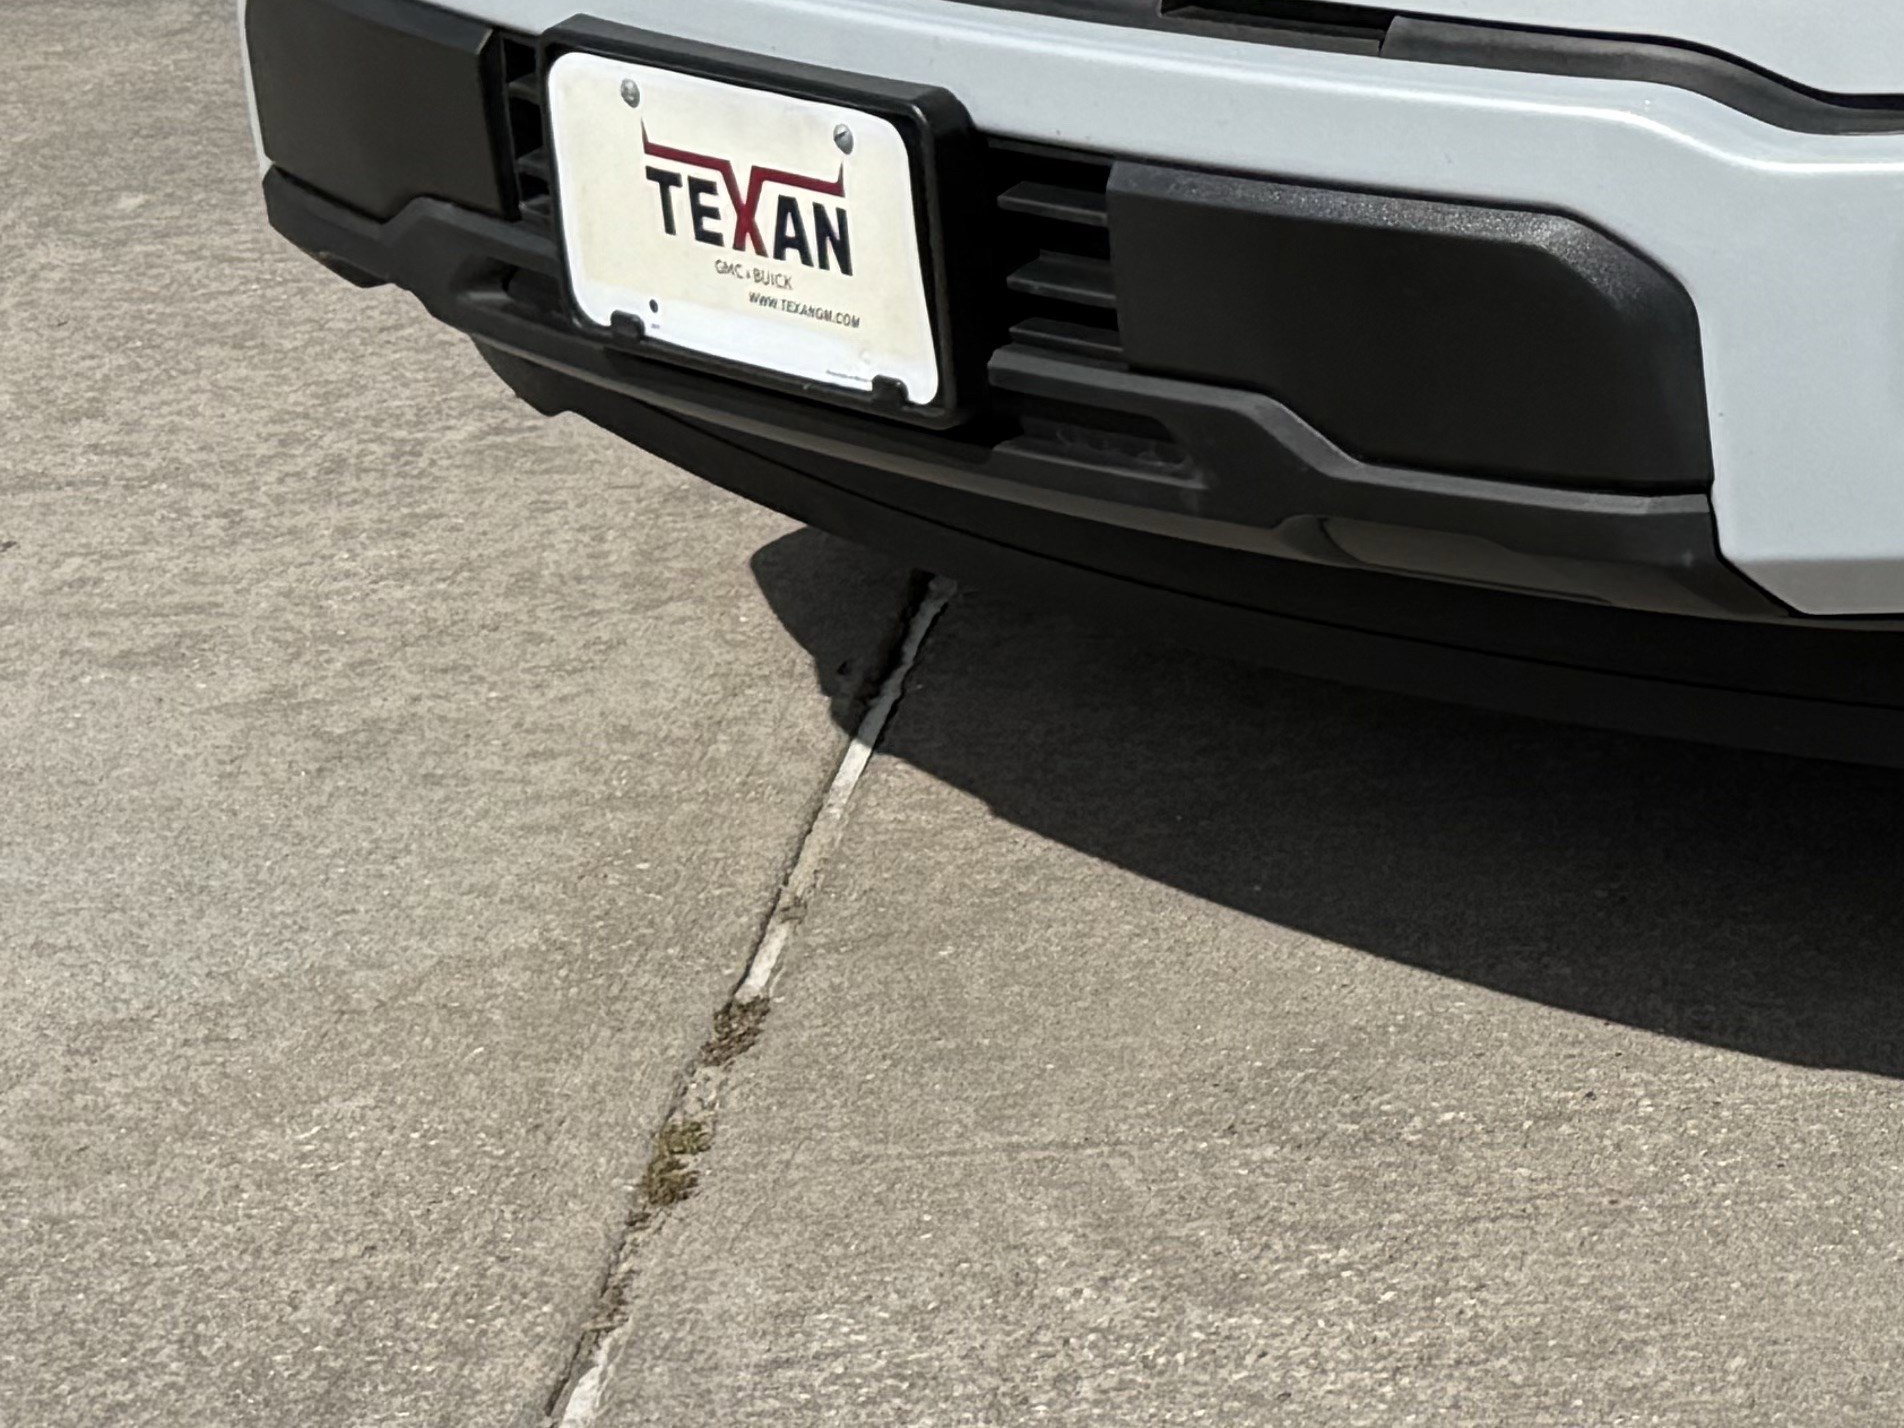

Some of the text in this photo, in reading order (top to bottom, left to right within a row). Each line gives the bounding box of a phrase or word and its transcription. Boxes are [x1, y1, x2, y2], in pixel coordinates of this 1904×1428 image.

[641, 142, 854, 277] TEXAN
[713, 258, 794, 291] GMC BUICK
